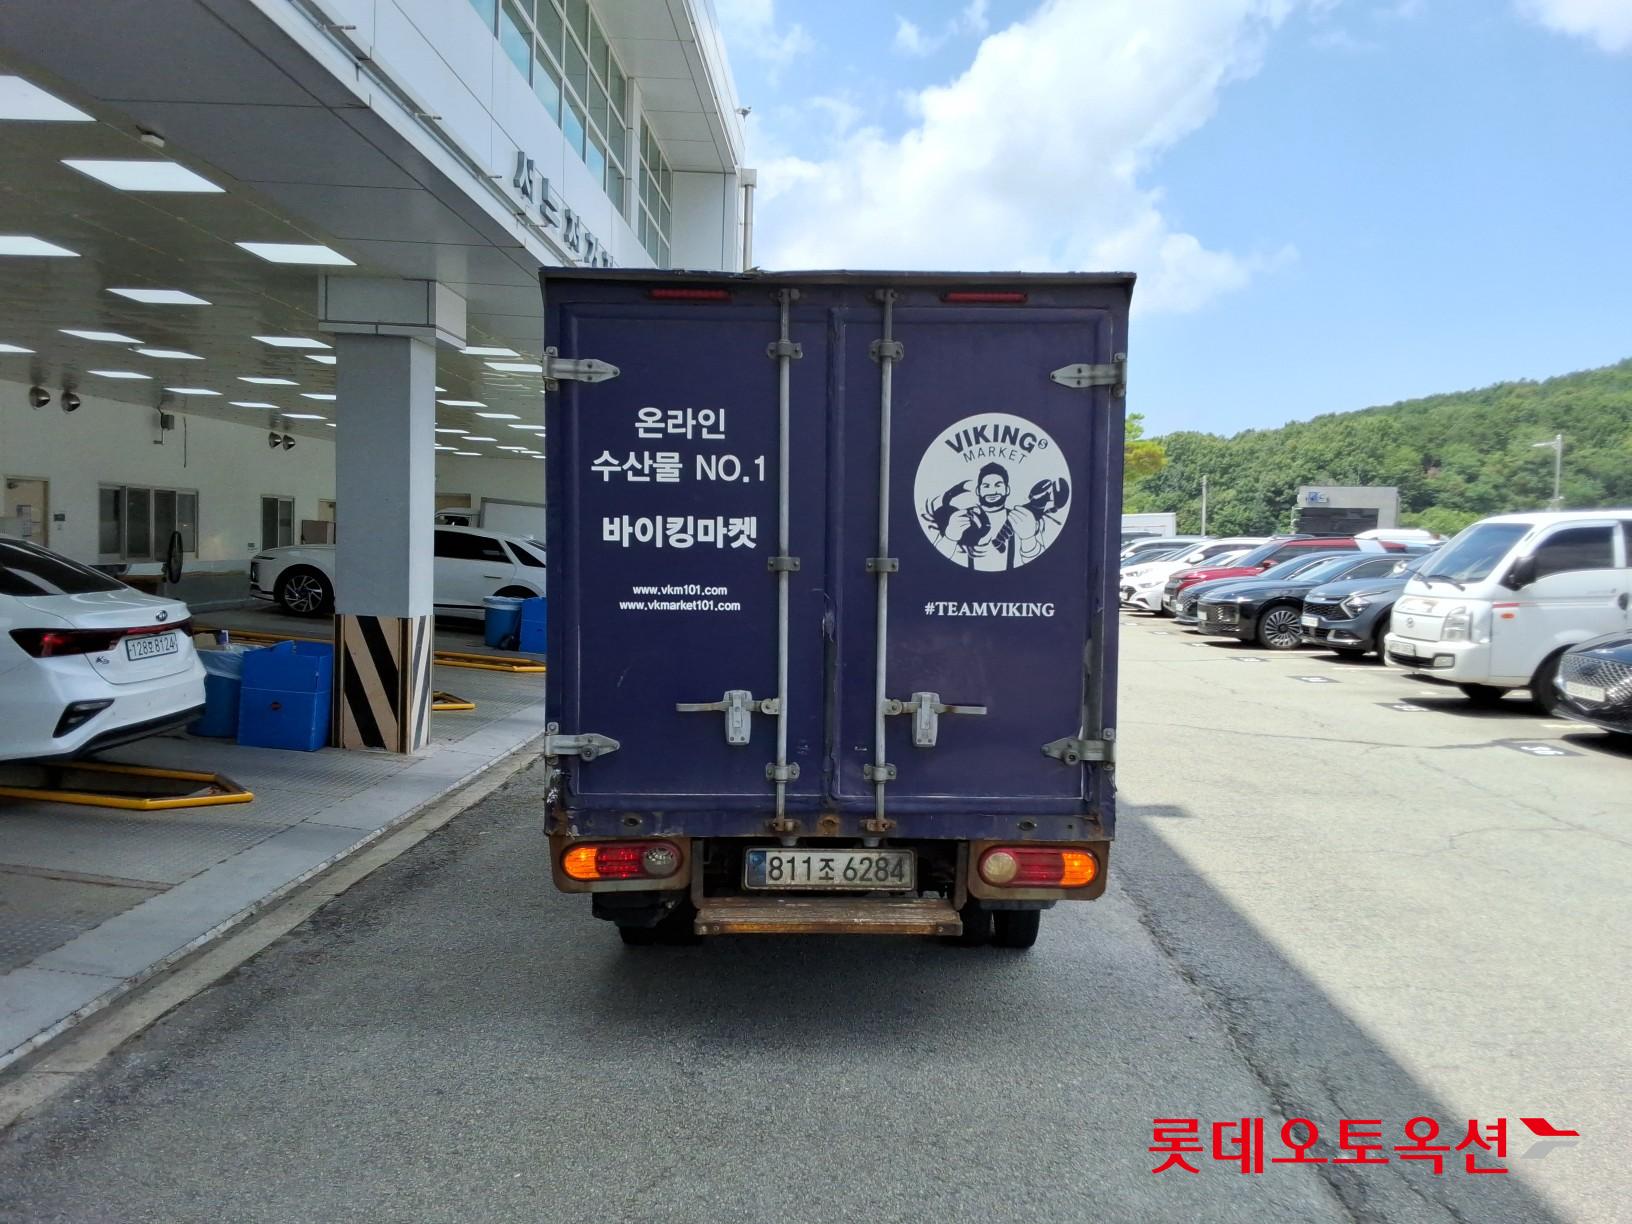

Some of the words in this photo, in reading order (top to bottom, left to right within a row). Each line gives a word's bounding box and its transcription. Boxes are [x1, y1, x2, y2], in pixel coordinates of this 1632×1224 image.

[634, 407, 726, 440] 온라인
[591, 450, 683, 483] 수산물
[696, 454, 765, 483] NO.1
[963, 446, 1027, 465] MARKET
[602, 514, 757, 549] 바이킹마켓
[632, 584, 728, 596] www.vkm101.com
[619, 600, 741, 612] www.vkmarket101.com
[924, 601, 1056, 617] #TEAMVIKING
[842, 856, 905, 882] 6284
